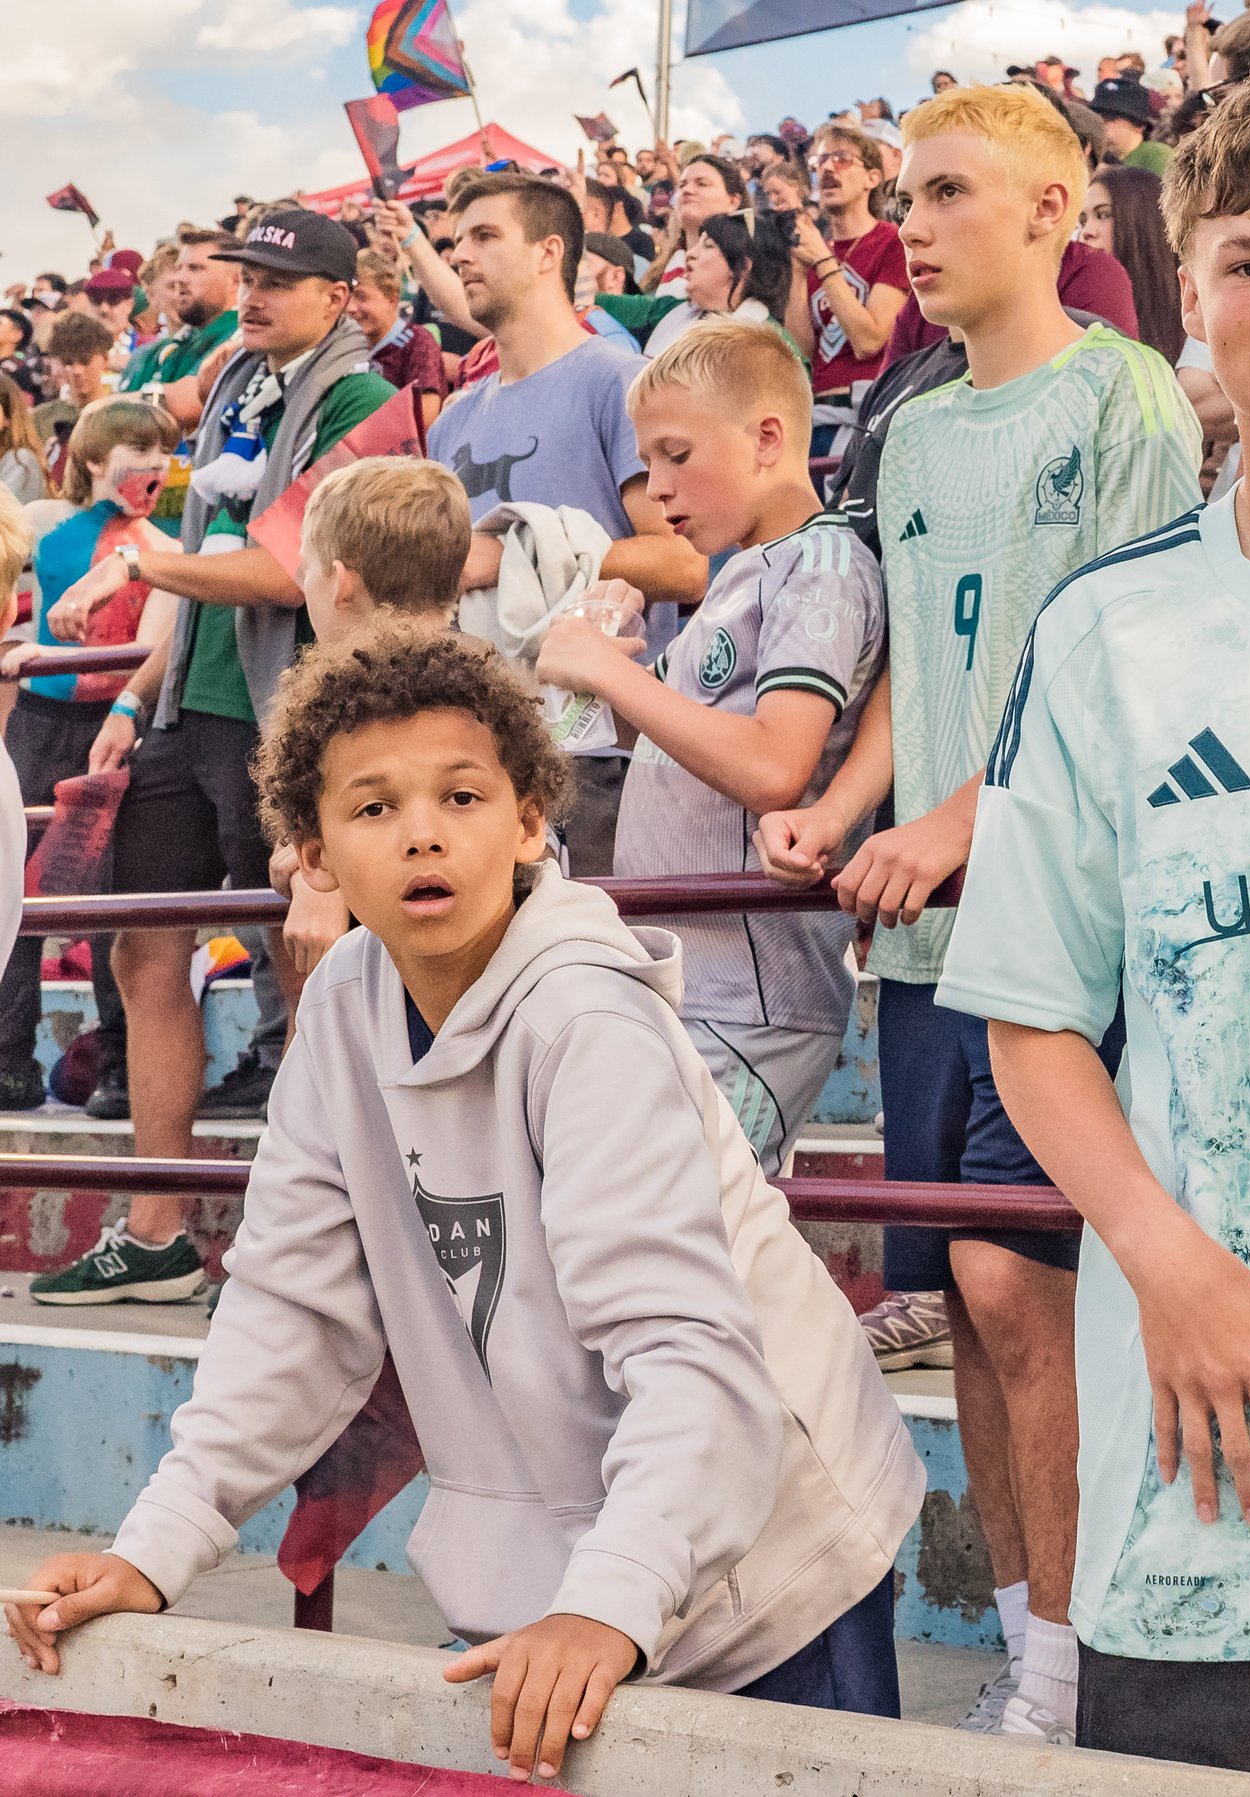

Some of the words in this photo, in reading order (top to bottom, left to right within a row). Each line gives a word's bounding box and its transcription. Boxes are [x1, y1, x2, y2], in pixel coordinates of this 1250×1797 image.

[954, 573, 982, 671] 9
[571, 702, 601, 739] BURRITO
[441, 1246, 481, 1260] CLUB
